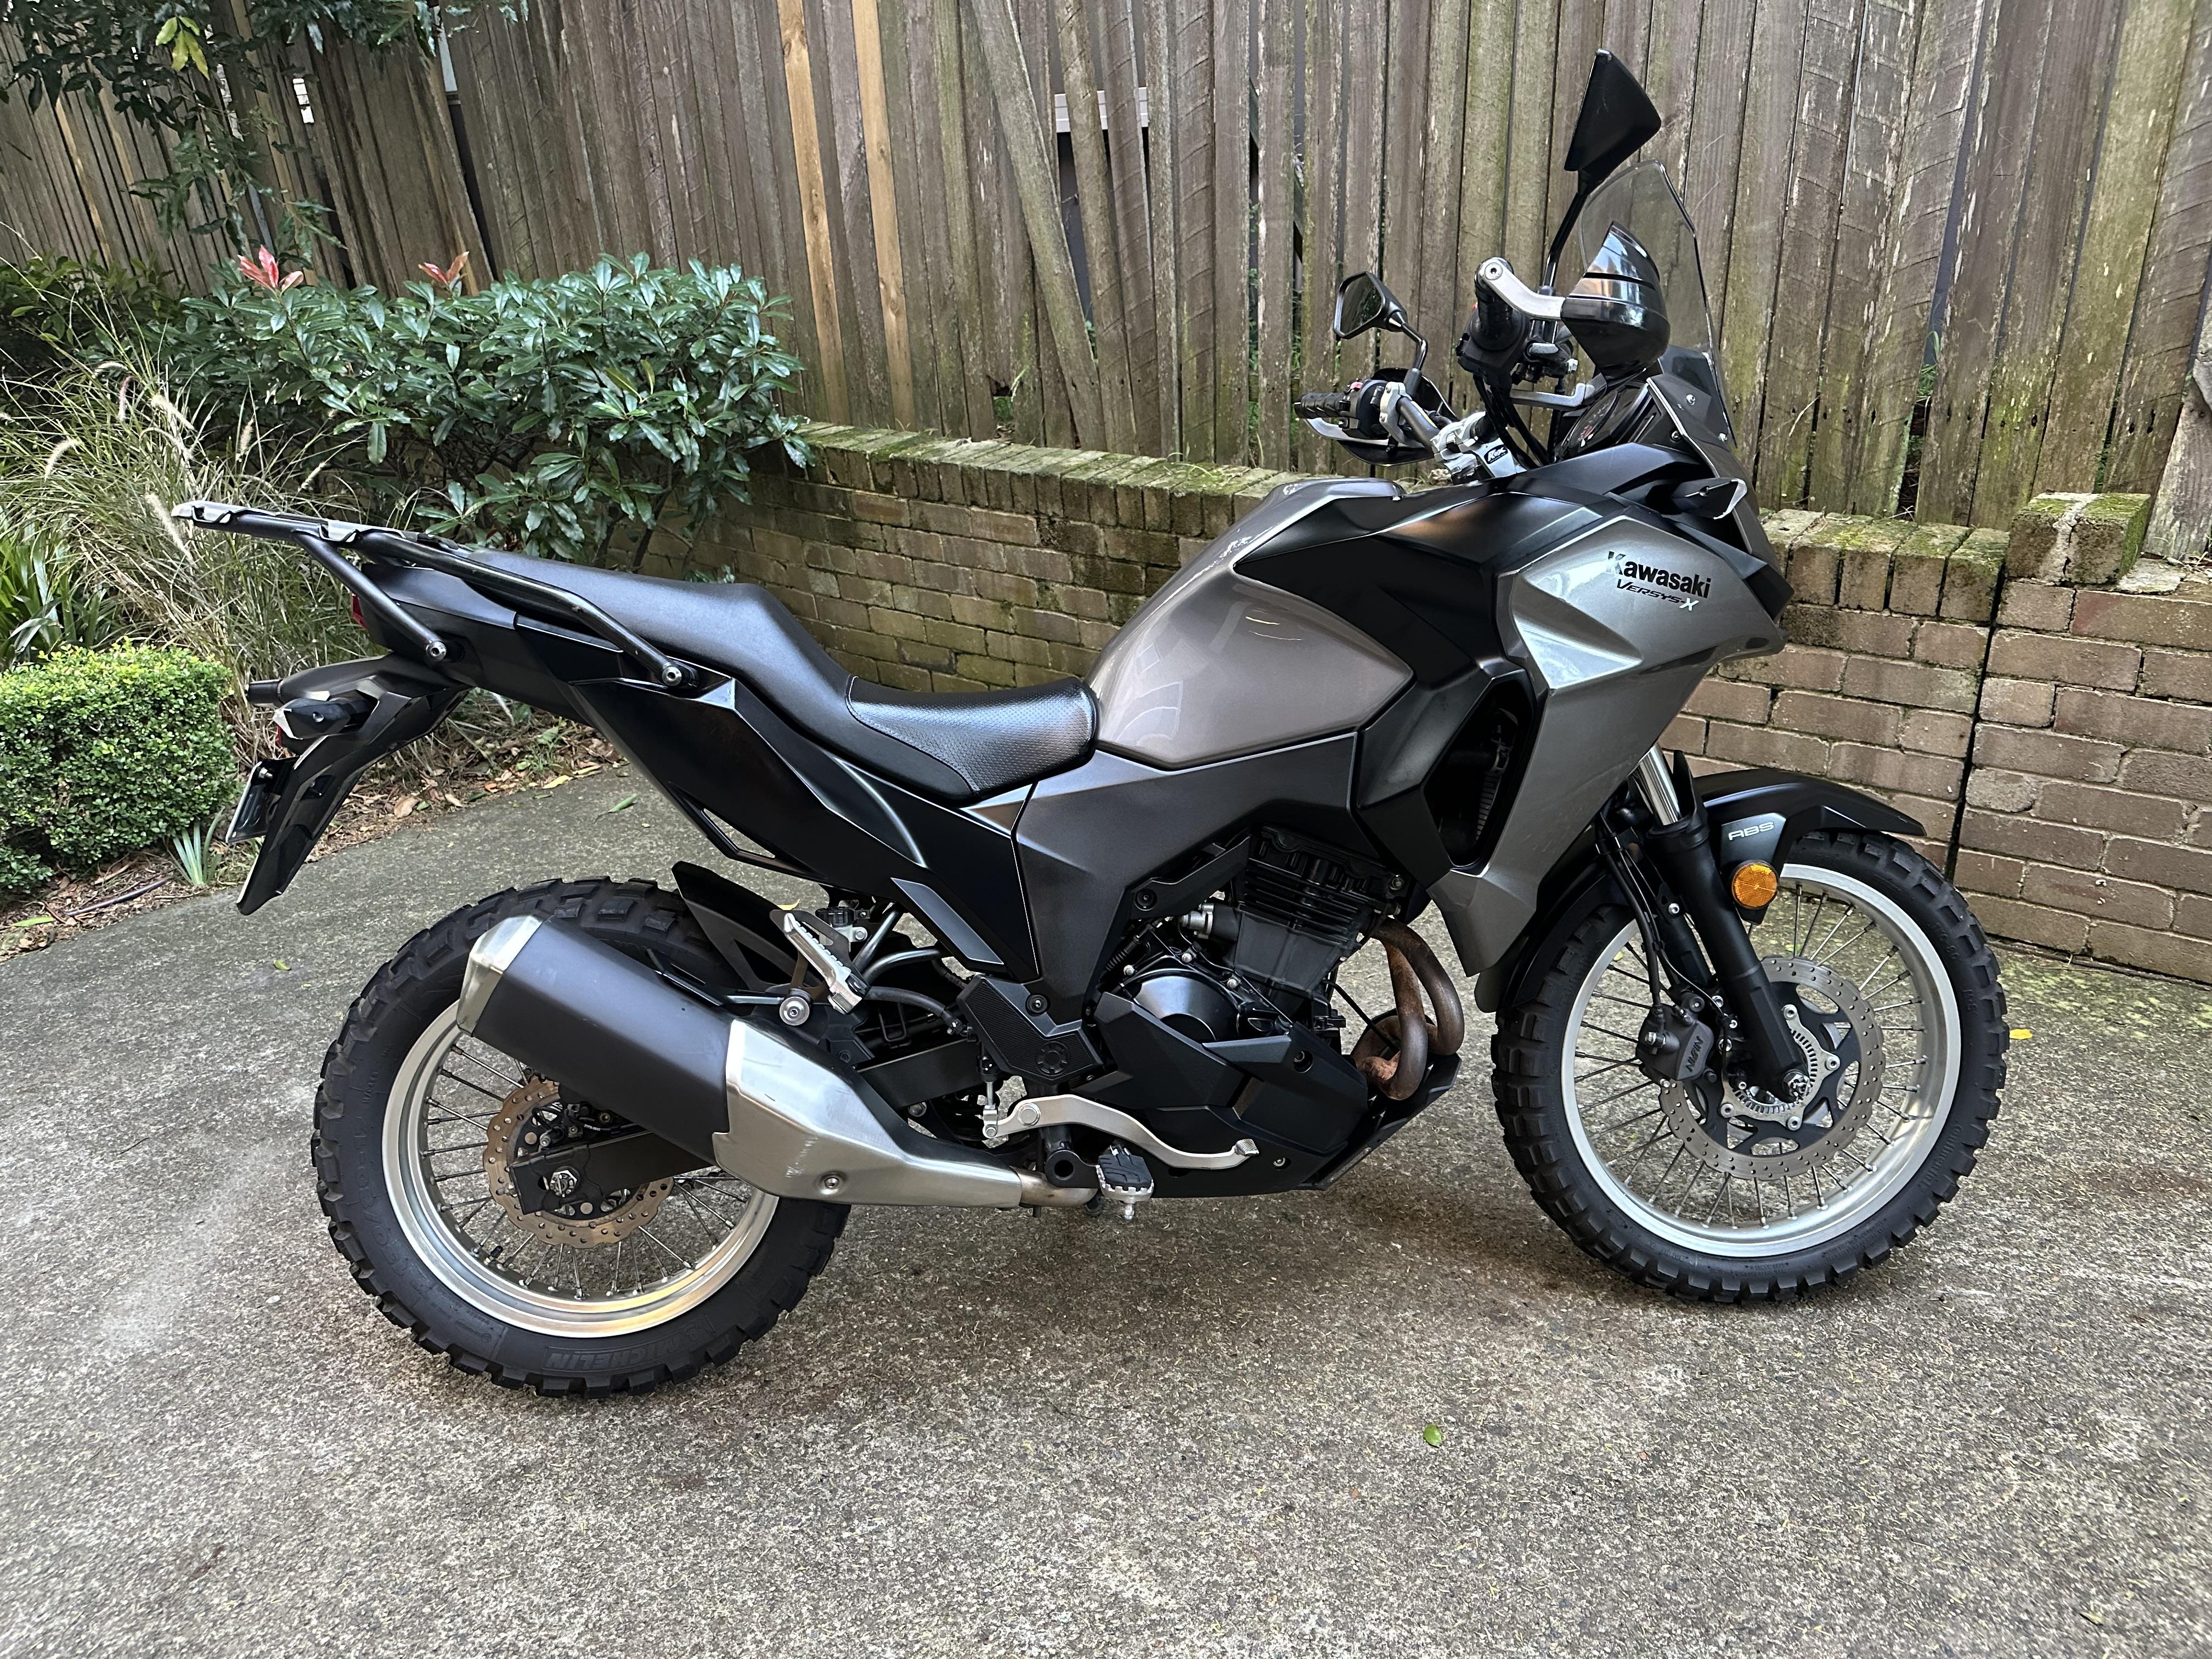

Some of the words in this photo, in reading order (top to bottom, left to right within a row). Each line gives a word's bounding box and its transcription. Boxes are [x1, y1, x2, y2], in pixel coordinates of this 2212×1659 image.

[1607, 551, 1711, 599] Kawasaki
[1728, 822, 1774, 841] ABS
[549, 1333, 685, 1370] MICHELIN
